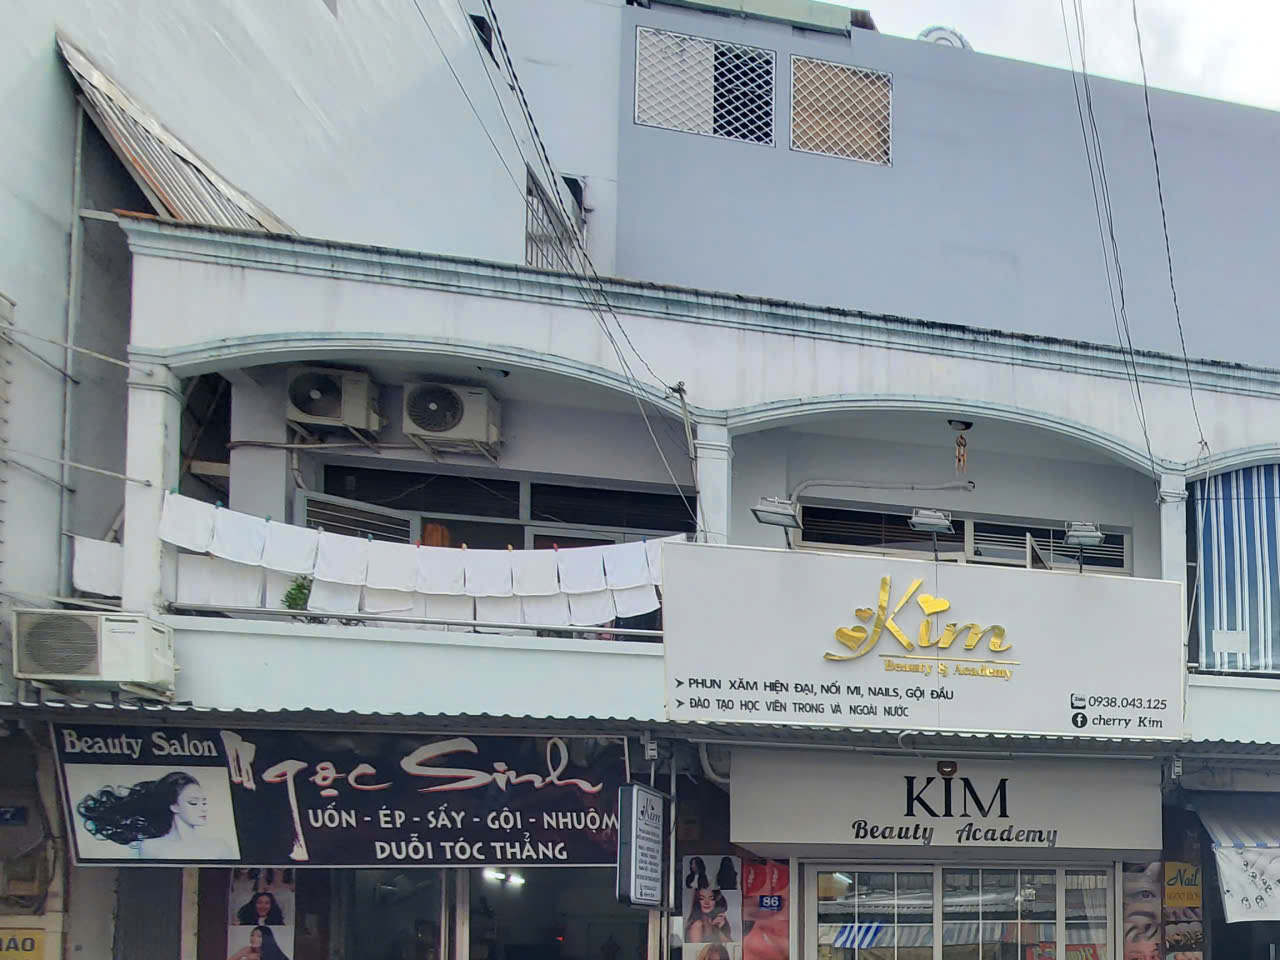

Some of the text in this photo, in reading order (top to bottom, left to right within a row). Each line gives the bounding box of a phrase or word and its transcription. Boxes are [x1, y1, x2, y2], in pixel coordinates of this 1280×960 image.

[823, 575, 1013, 662] Kim
[885, 659, 932, 676] Beauty
[953, 664, 1014, 681] Academy
[688, 677, 955, 701] PHUN XĂM HIỆN ĐẠI, NỐI MI, NAILS, GỘI ĐẦU
[689, 695, 910, 717] ĐÀO TẠO HỌC VIÊN TRONG VÀ NGOÀI NƯỚC
[1088, 695, 1168, 711] 0938.043.125
[1091, 714, 1163, 729] cherry Kim
[61, 728, 219, 760] Beauty Salon
[219, 729, 604, 862] Ngọc Sinh
[903, 775, 1010, 819] KIM
[307, 801, 358, 829] UỐN
[378, 804, 407, 829] ÉP
[426, 802, 466, 829] SẤY
[486, 807, 523, 833] GỘI
[542, 806, 619, 833] NHUỘM
[374, 831, 569, 861] DUỖI TÓC THẲNG
[851, 819, 1059, 848] Beauty Academy
[1167, 867, 1200, 887] Nail
[762, 896, 780, 907] 86
